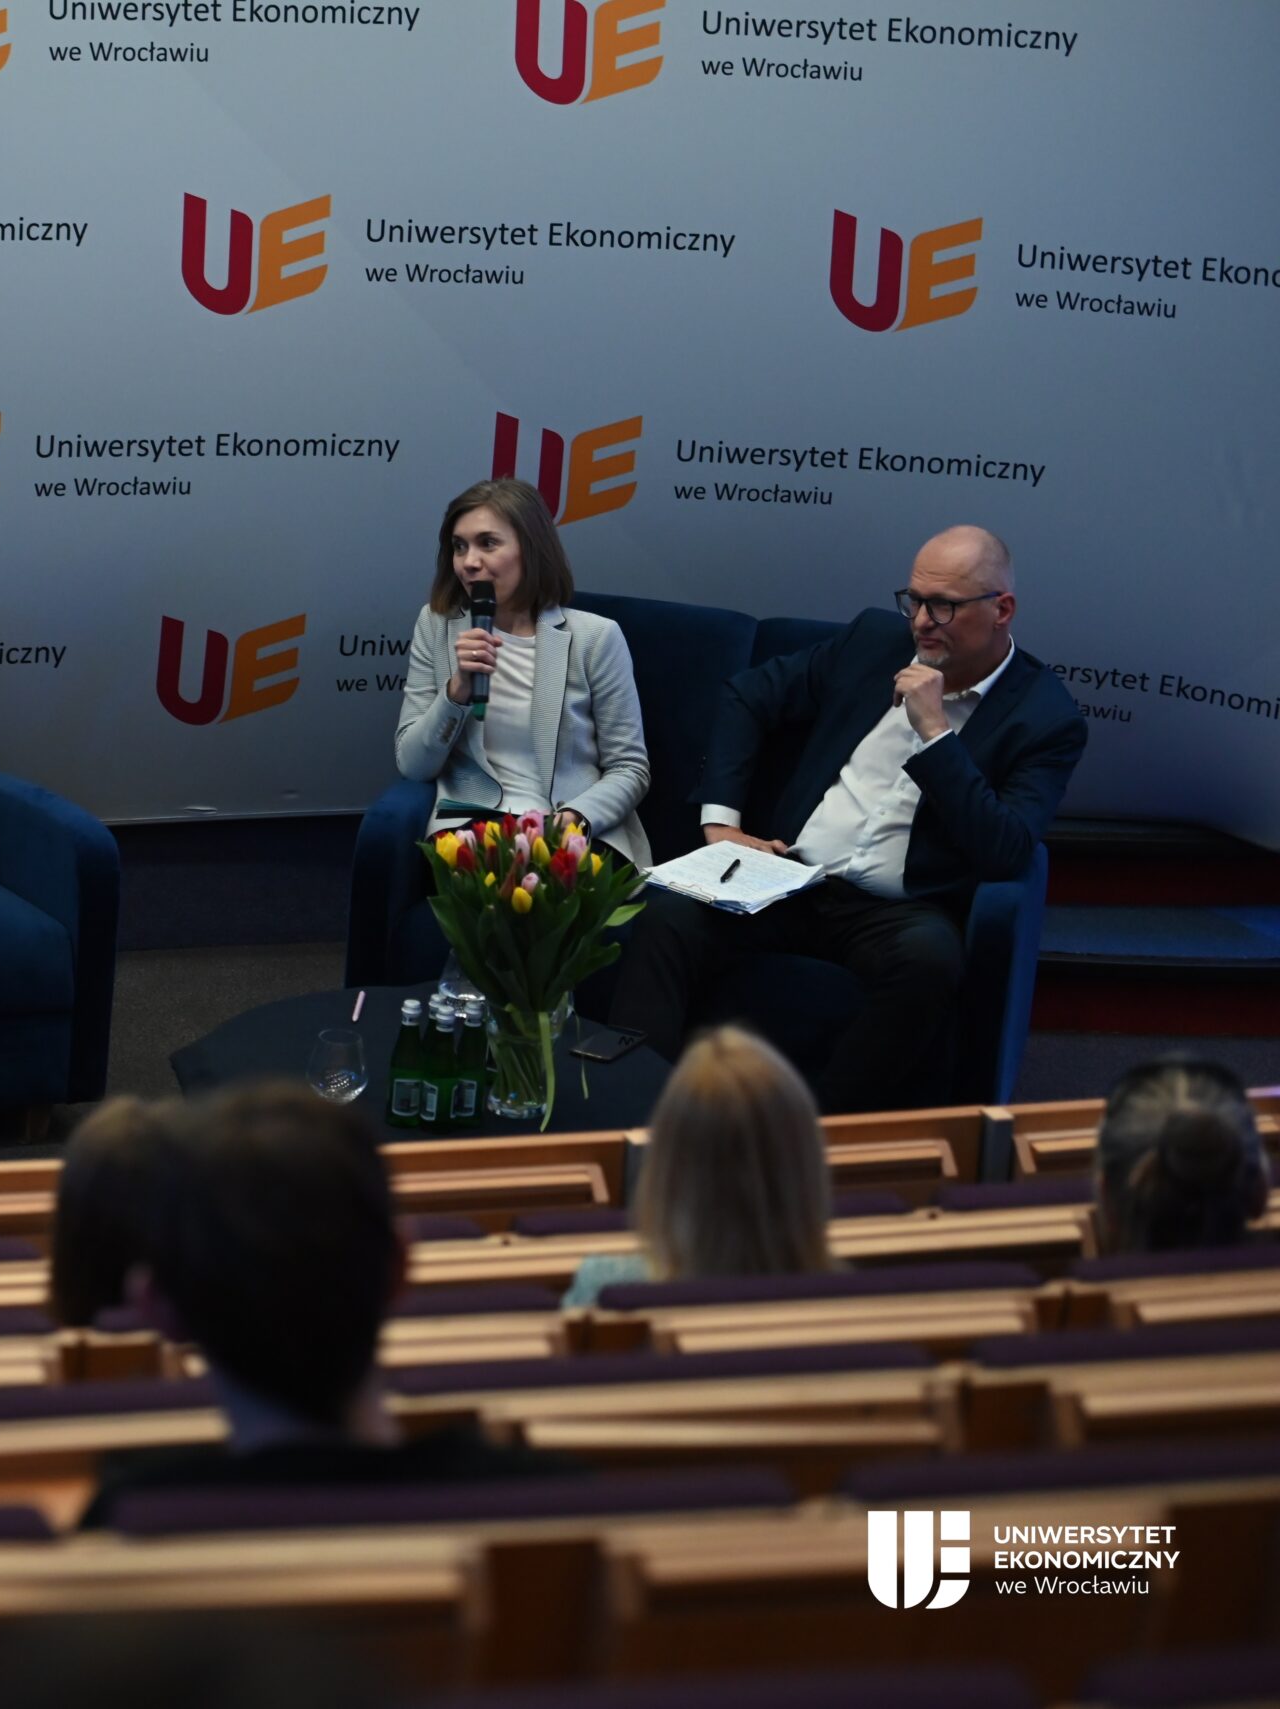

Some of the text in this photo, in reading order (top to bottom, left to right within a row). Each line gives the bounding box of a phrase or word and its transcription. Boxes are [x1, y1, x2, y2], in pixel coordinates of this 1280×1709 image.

[48, 0, 421, 32] Uniwersytet Ekonomiczny
[702, 9, 1079, 58] Uniwersytet Ekonomiczny
[48, 40, 209, 63] we Wrocławiu
[515, 0, 668, 106] UE
[700, 56, 863, 82] we Wrocławiu
[182, 192, 332, 315] UE
[366, 218, 736, 259] Uniwersytet Ekonomiczny
[364, 263, 525, 285] we Wrocławiu
[830, 209, 985, 331] UE
[1017, 243, 1193, 283] Uniwersytet
[1015, 290, 1177, 319] we Wrocławiu
[35, 431, 401, 464] Uniwersytet Ekonomiczny
[676, 439, 1046, 488] Uniwersytet Ekonomiczny
[33, 475, 192, 498] we Wrocławiu
[673, 482, 833, 506] we Wrocławiu
[156, 613, 307, 726] UE
[335, 678, 369, 693] we
[1048, 664, 1280, 720] ersytet Ekonomi
